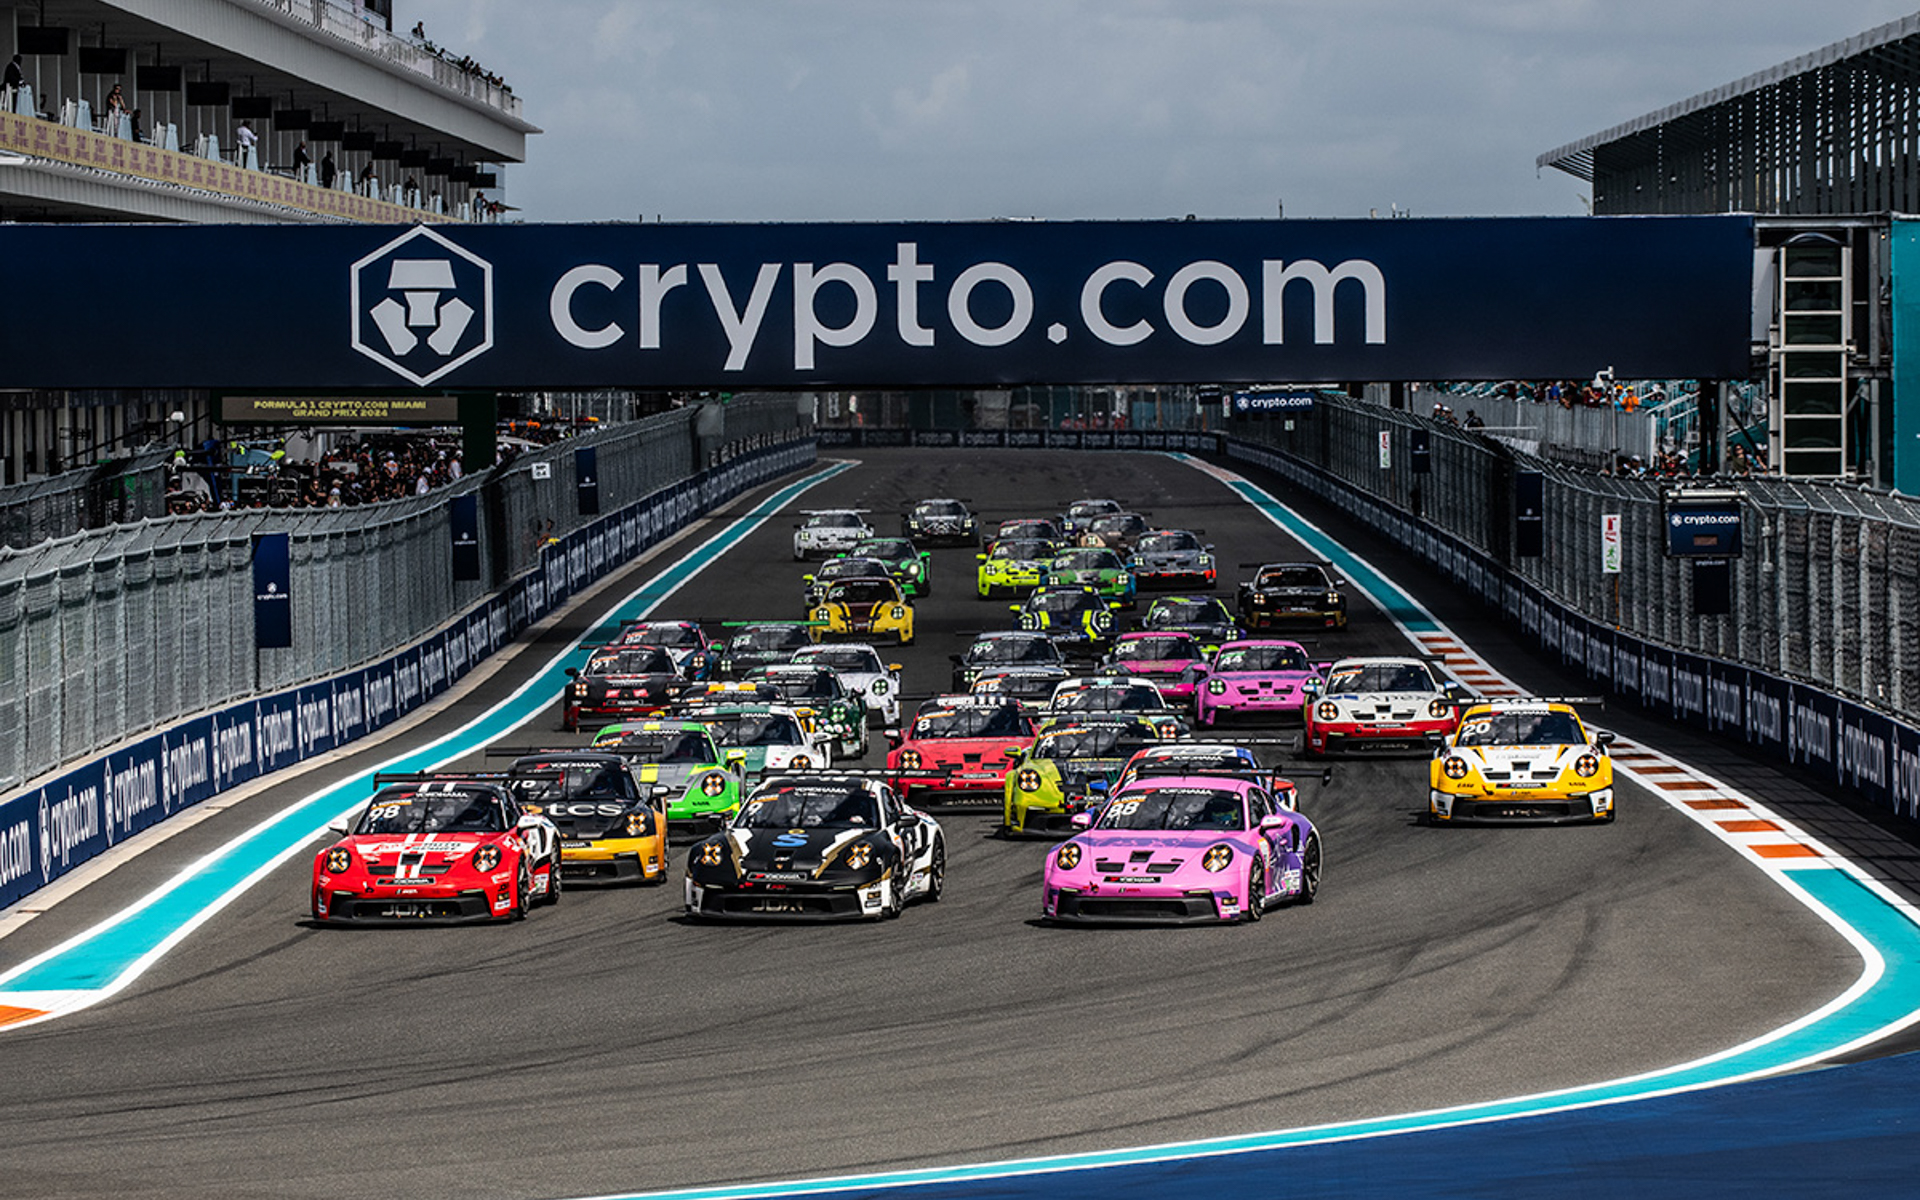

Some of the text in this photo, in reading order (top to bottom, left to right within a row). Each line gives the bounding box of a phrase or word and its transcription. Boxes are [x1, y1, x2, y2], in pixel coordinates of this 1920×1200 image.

[549, 241, 1387, 371] crypto.com
[254, 401, 307, 409] FORMULA
[318, 401, 388, 409] CRYPTO.COM
[391, 401, 426, 409] MIAMI
[1251, 397, 1312, 408] crypto.com
[292, 409, 388, 417] GRAND PRIX 2024
[1683, 515, 1739, 525] crypto.com
[917, 719, 931, 732] 8
[1461, 722, 1491, 738] 20
[114, 756, 158, 832] crypto.com
[415, 790, 469, 799] YOKOHAMA
[794, 786, 850, 795] YOKOHAMA
[1159, 788, 1216, 796] YOKOHAMA
[369, 804, 401, 820] 98
[545, 803, 623, 817] tcs
[1108, 802, 1141, 819] 88
[51, 785, 99, 867] crypto.com
[0, 819, 31, 887] o.com
